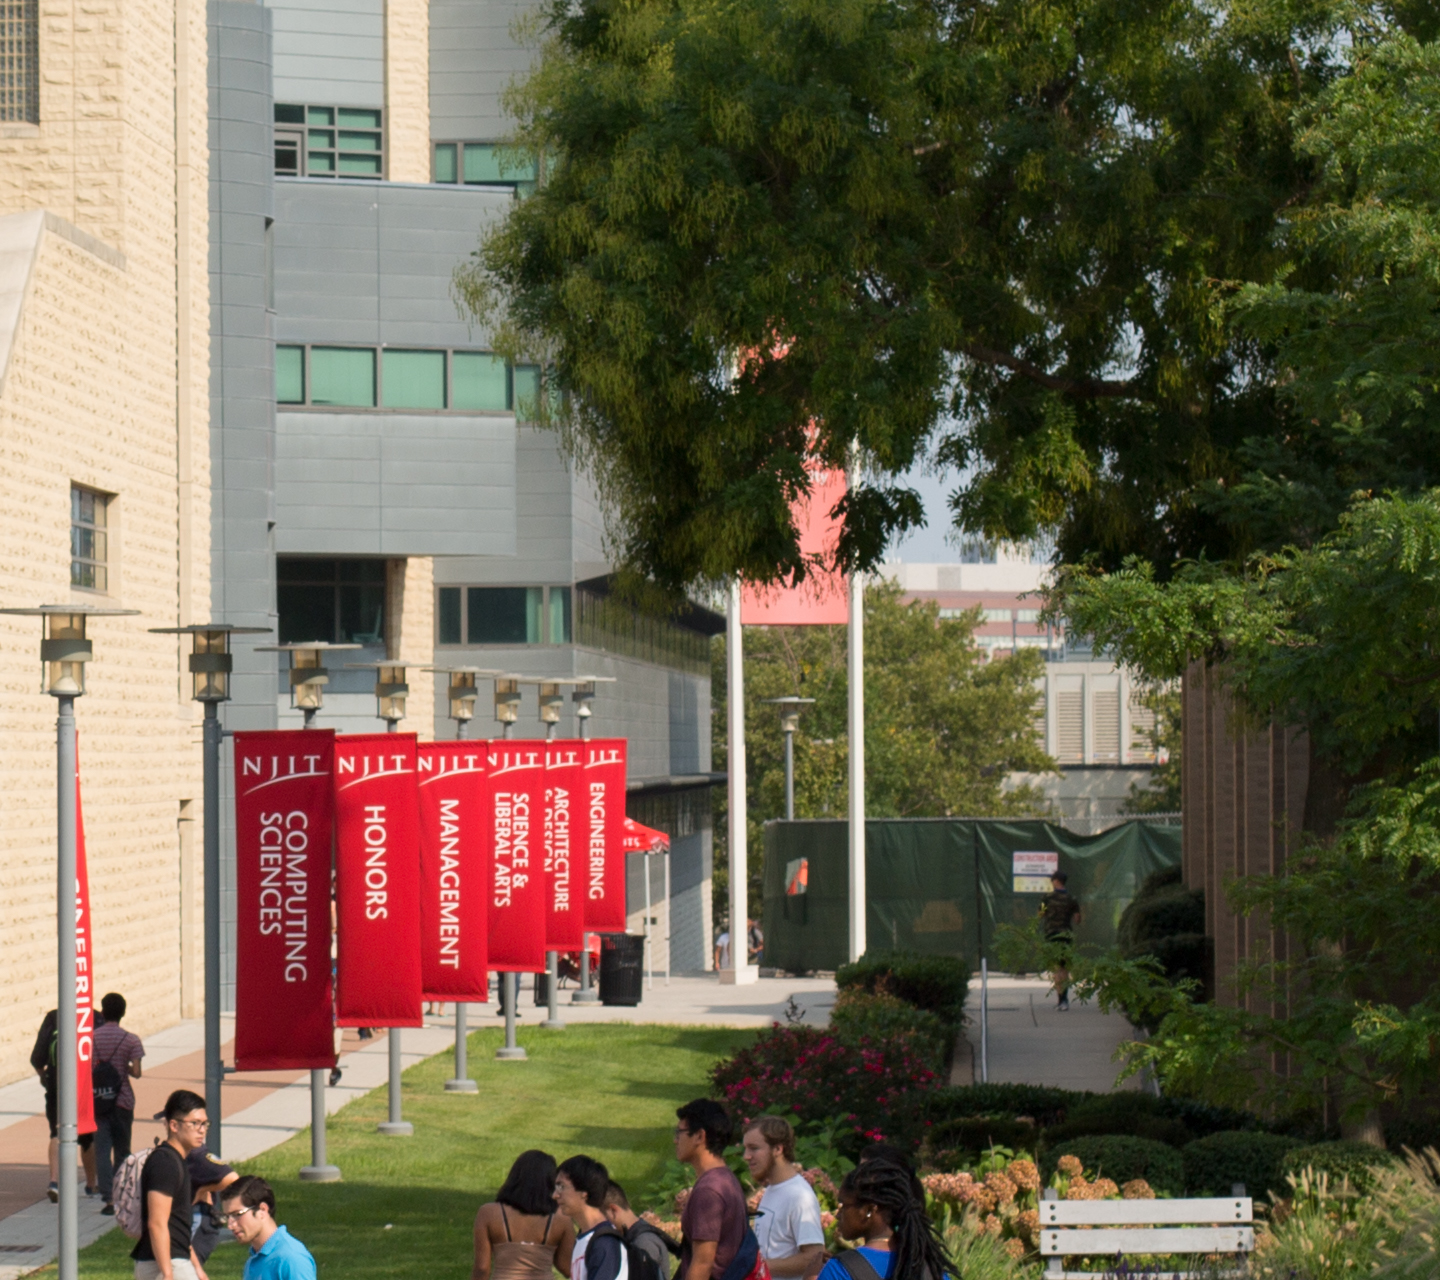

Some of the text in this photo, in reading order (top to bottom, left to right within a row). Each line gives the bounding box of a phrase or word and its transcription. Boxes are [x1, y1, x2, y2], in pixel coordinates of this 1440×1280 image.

[243, 755, 321, 780] NJIT
[338, 754, 408, 778] NJIT
[417, 755, 480, 776] NJIT
[589, 749, 620, 766] JIT
[259, 812, 283, 935] SCIENCES
[284, 810, 308, 982] COMPUTING
[364, 805, 388, 920] HONORS
[439, 799, 460, 969] MANAGEMENT
[494, 792, 511, 907] LIBERAL ARTS
[512, 793, 530, 888] SCIENCE &
[553, 787, 570, 911] ARCHITECTURE
[589, 782, 606, 900] ENGINEERING
